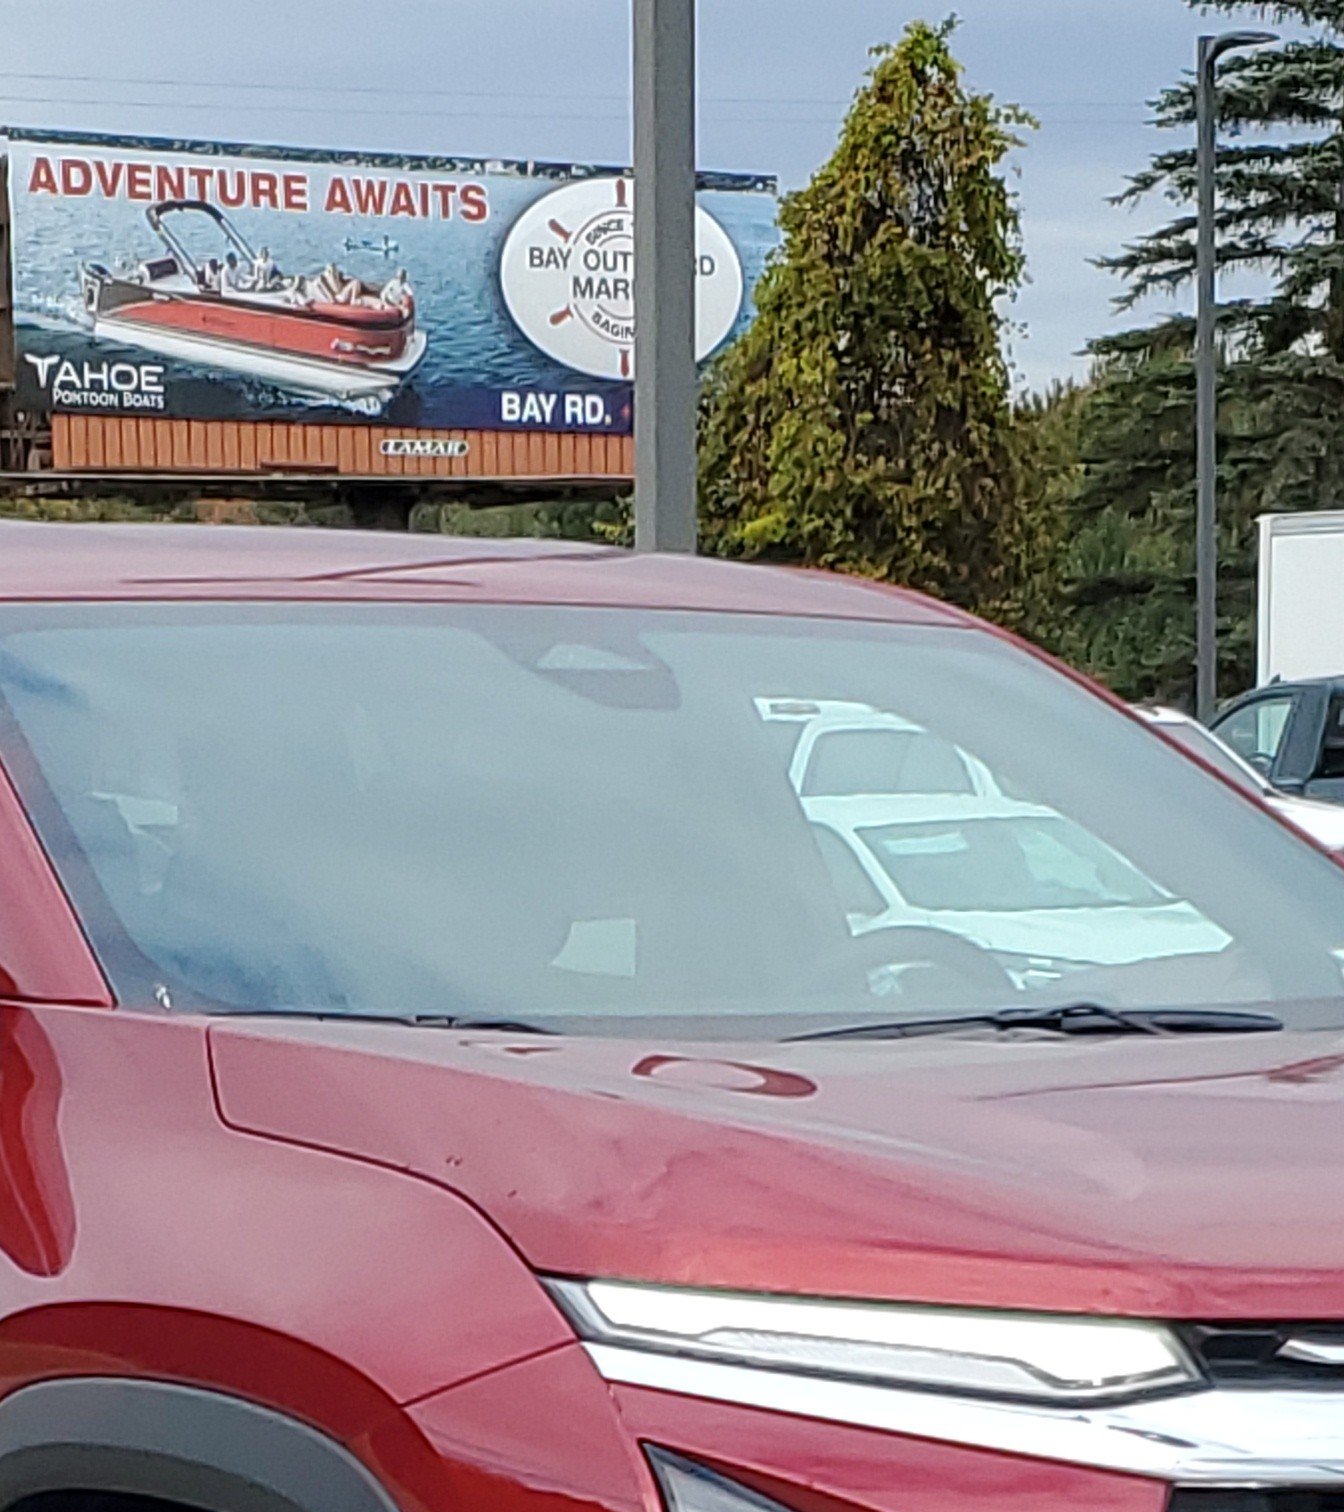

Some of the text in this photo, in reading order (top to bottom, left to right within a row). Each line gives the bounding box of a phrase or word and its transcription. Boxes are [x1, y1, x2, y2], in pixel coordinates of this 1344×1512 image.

[28, 156, 490, 222] ADVENTURE AWAITS
[529, 246, 571, 270] BAY
[573, 276, 633, 300] MAR
[24, 353, 164, 393] TAHOE
[52, 387, 164, 409] PONTOON BOATS
[501, 391, 612, 425] BAY RD.
